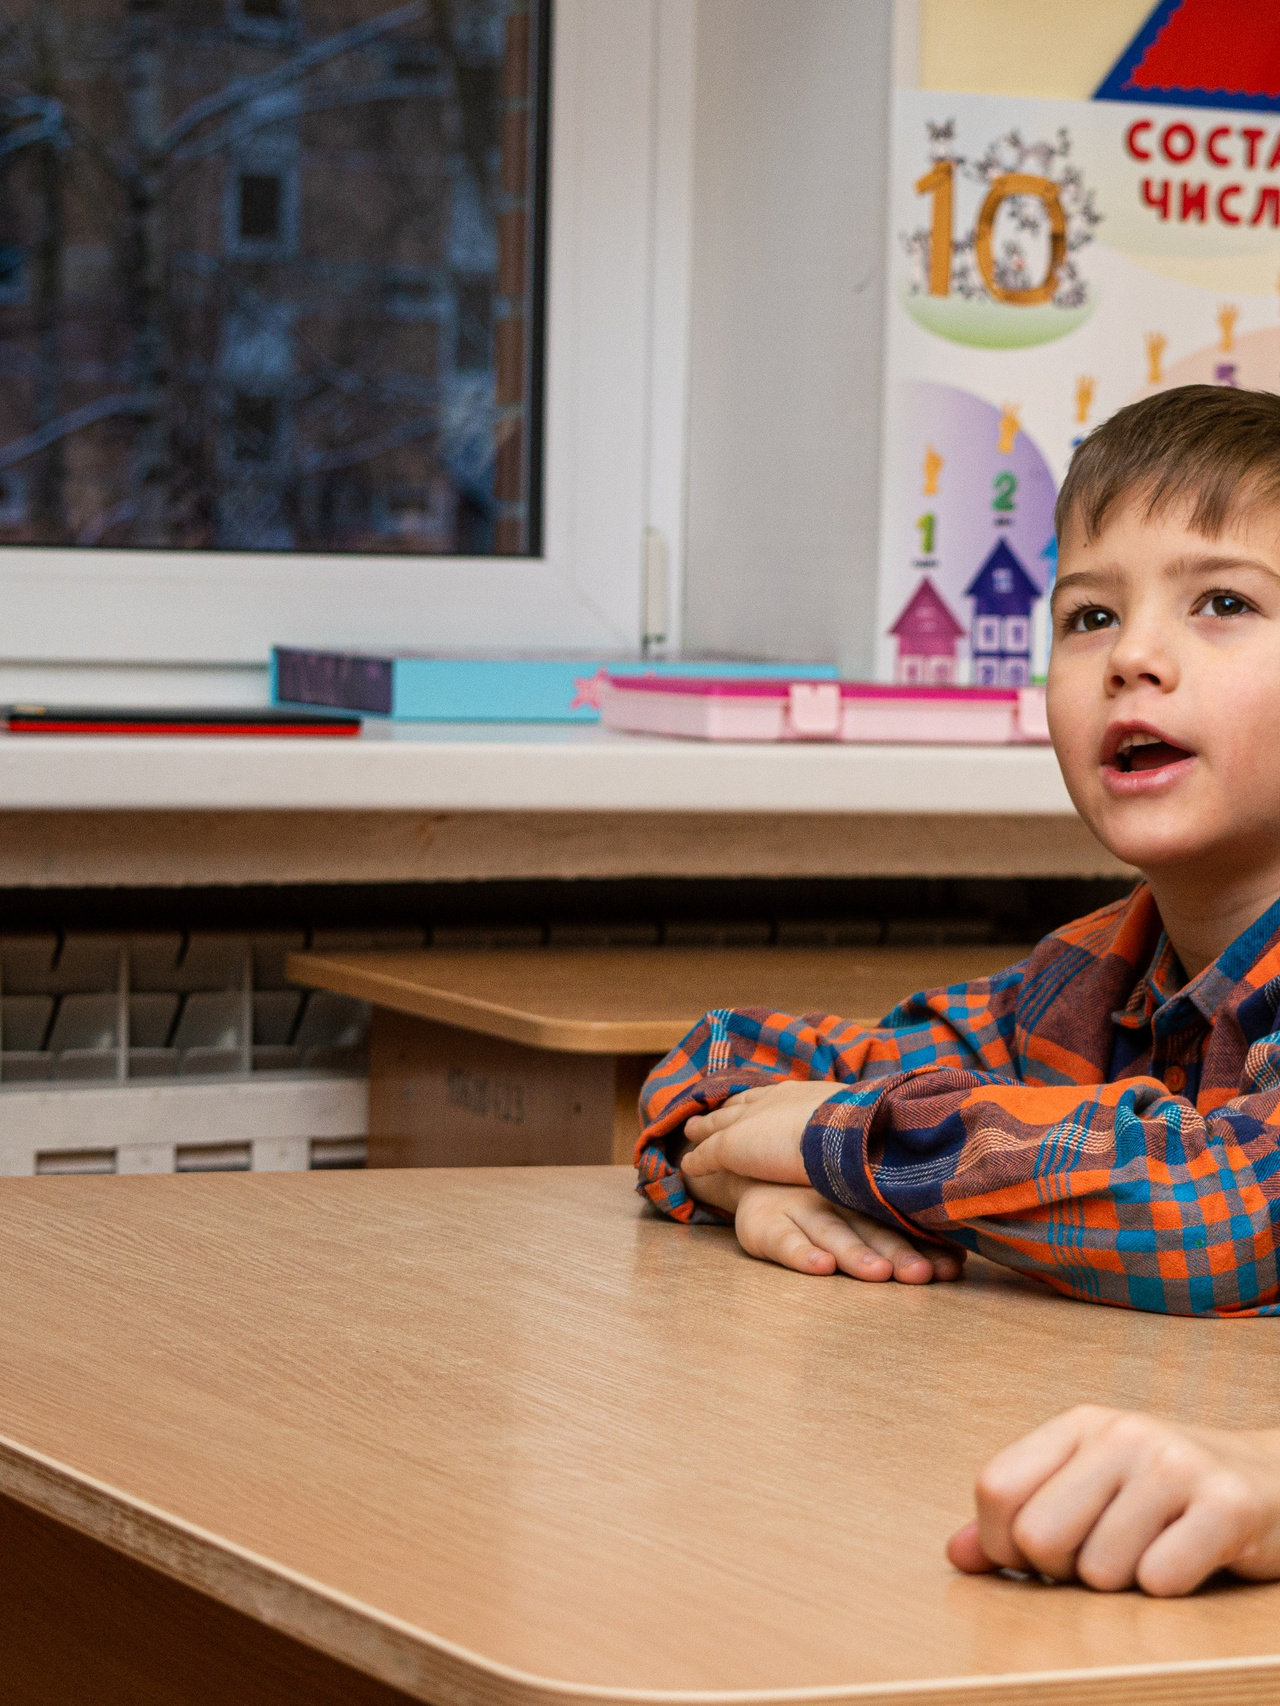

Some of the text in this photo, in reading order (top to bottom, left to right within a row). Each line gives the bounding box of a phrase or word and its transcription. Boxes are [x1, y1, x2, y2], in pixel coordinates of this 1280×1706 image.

[914, 160, 1067, 307] 10
[992, 472, 1018, 511] 2
[917, 513, 935, 553] 1
